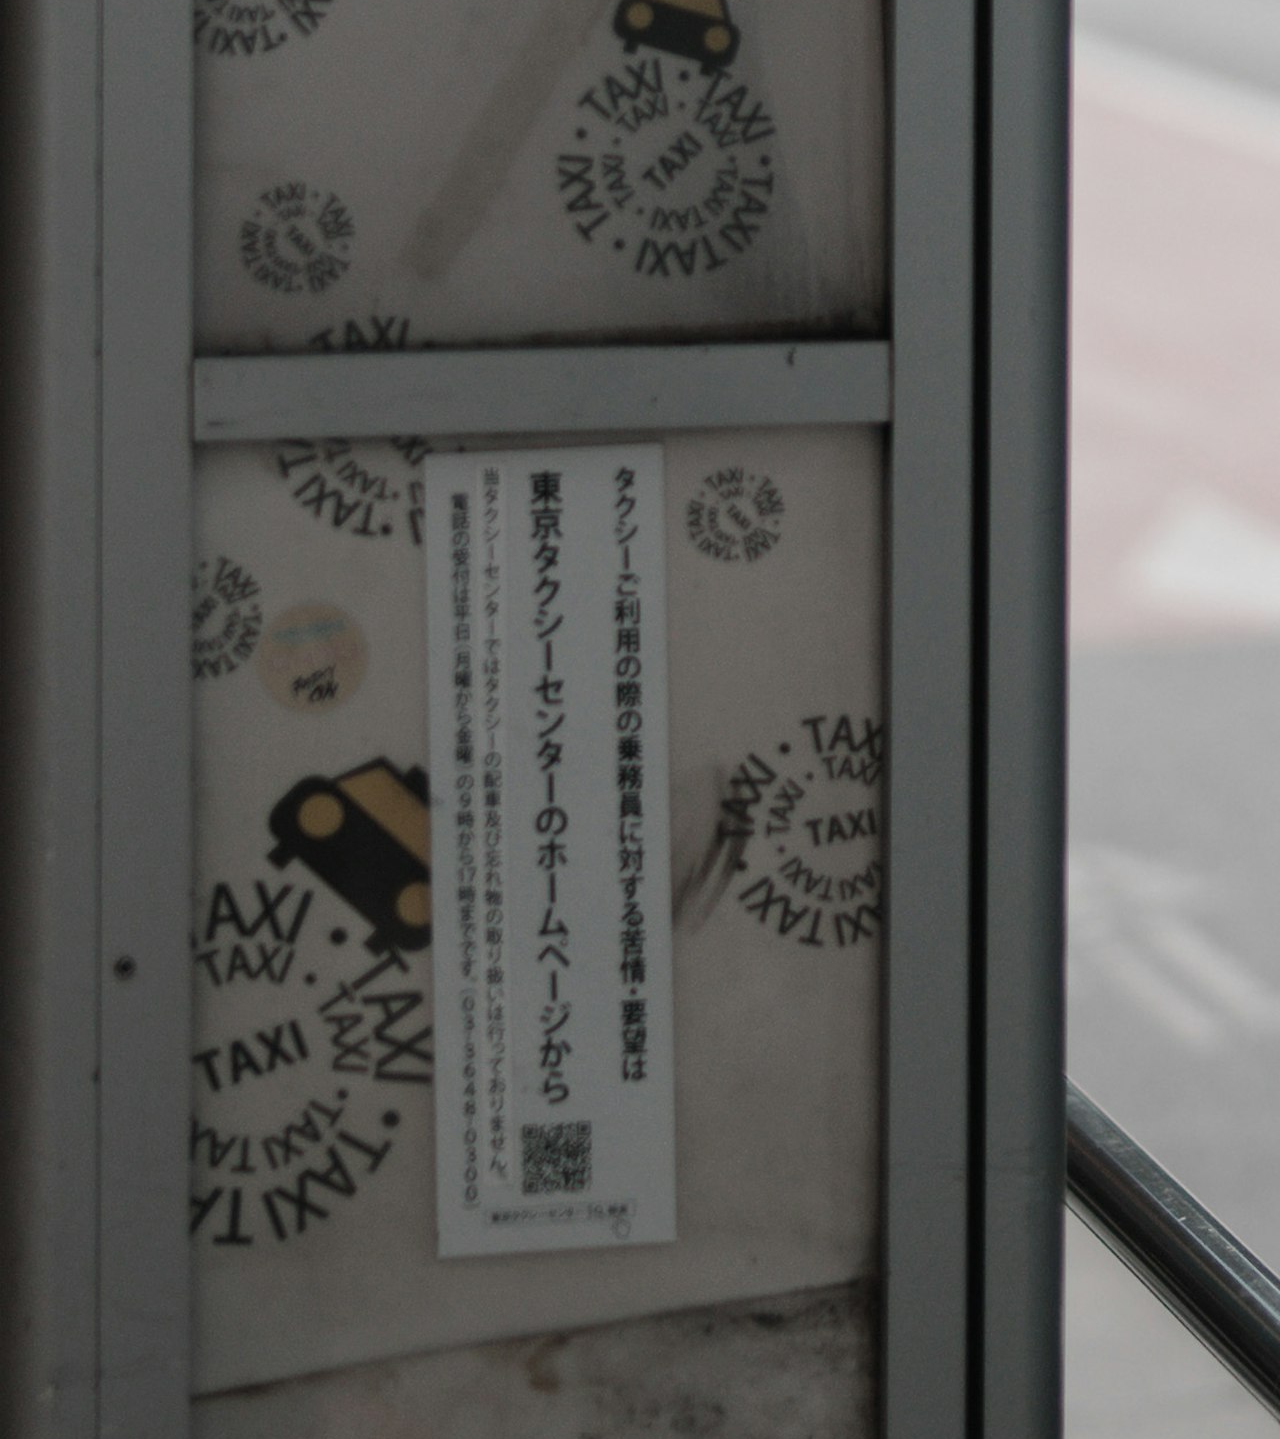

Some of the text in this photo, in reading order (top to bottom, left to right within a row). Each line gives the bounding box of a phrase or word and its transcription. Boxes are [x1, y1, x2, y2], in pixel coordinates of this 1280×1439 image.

[209, 24, 280, 55] TAXI
[577, 59, 663, 120] TAXI
[616, 92, 669, 132] TAXI
[695, 70, 776, 144] TAXI
[602, 154, 635, 208] TAXI
[642, 131, 702, 190] TAXI
[704, 166, 738, 216] TAXI
[558, 154, 610, 242] TAXI
[650, 205, 707, 232] TAXI
[719, 172, 774, 252] TAXI
[635, 235, 729, 277] TAXI
[293, 472, 376, 536] TAXI
[528, 470, 572, 1105] 東京タクシーセンターのホームページから
[717, 753, 777, 841] TAXI
[765, 777, 805, 838] TAXI
[805, 807, 877, 847] TAXI
[779, 856, 833, 901] TAXI
[205, 881, 314, 942] AXI
[738, 876, 824, 948] TAXI
[199, 943, 295, 987] TAXI
[317, 980, 370, 1072] TAXI
[350, 944, 433, 1084] TAXI
[194, 1020, 309, 1092] TAXI
[261, 1099, 344, 1169] TAXI
[263, 1130, 393, 1242] TAXI
